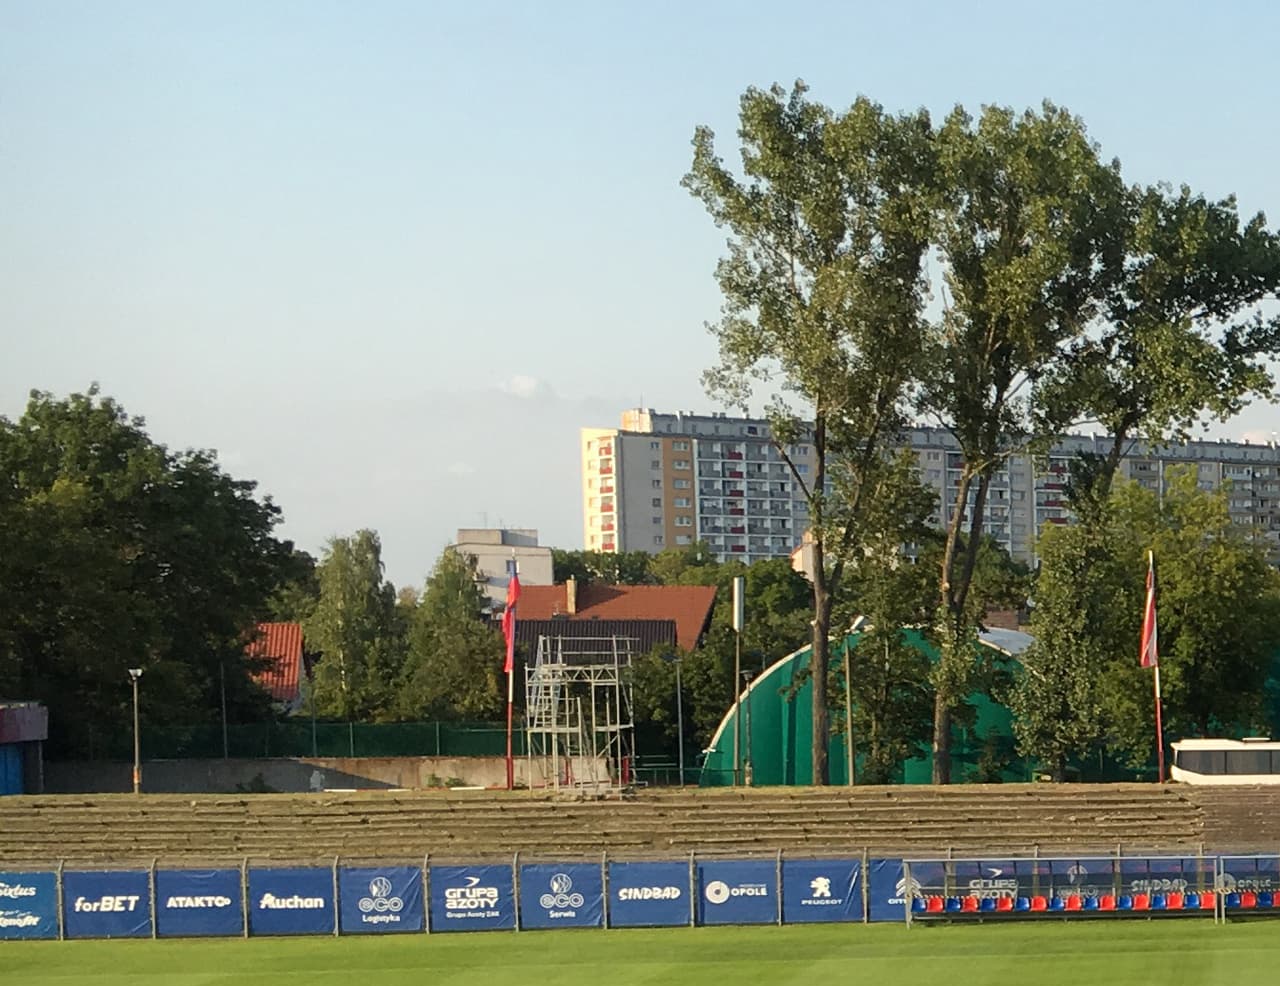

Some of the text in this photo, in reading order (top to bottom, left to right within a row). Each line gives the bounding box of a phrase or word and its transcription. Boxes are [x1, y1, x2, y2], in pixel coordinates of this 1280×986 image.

[618, 886, 681, 900] SINDBAD
[731, 887, 768, 896] OPOLE
[74, 895, 140, 912] forBET
[259, 893, 324, 909] Auchan
